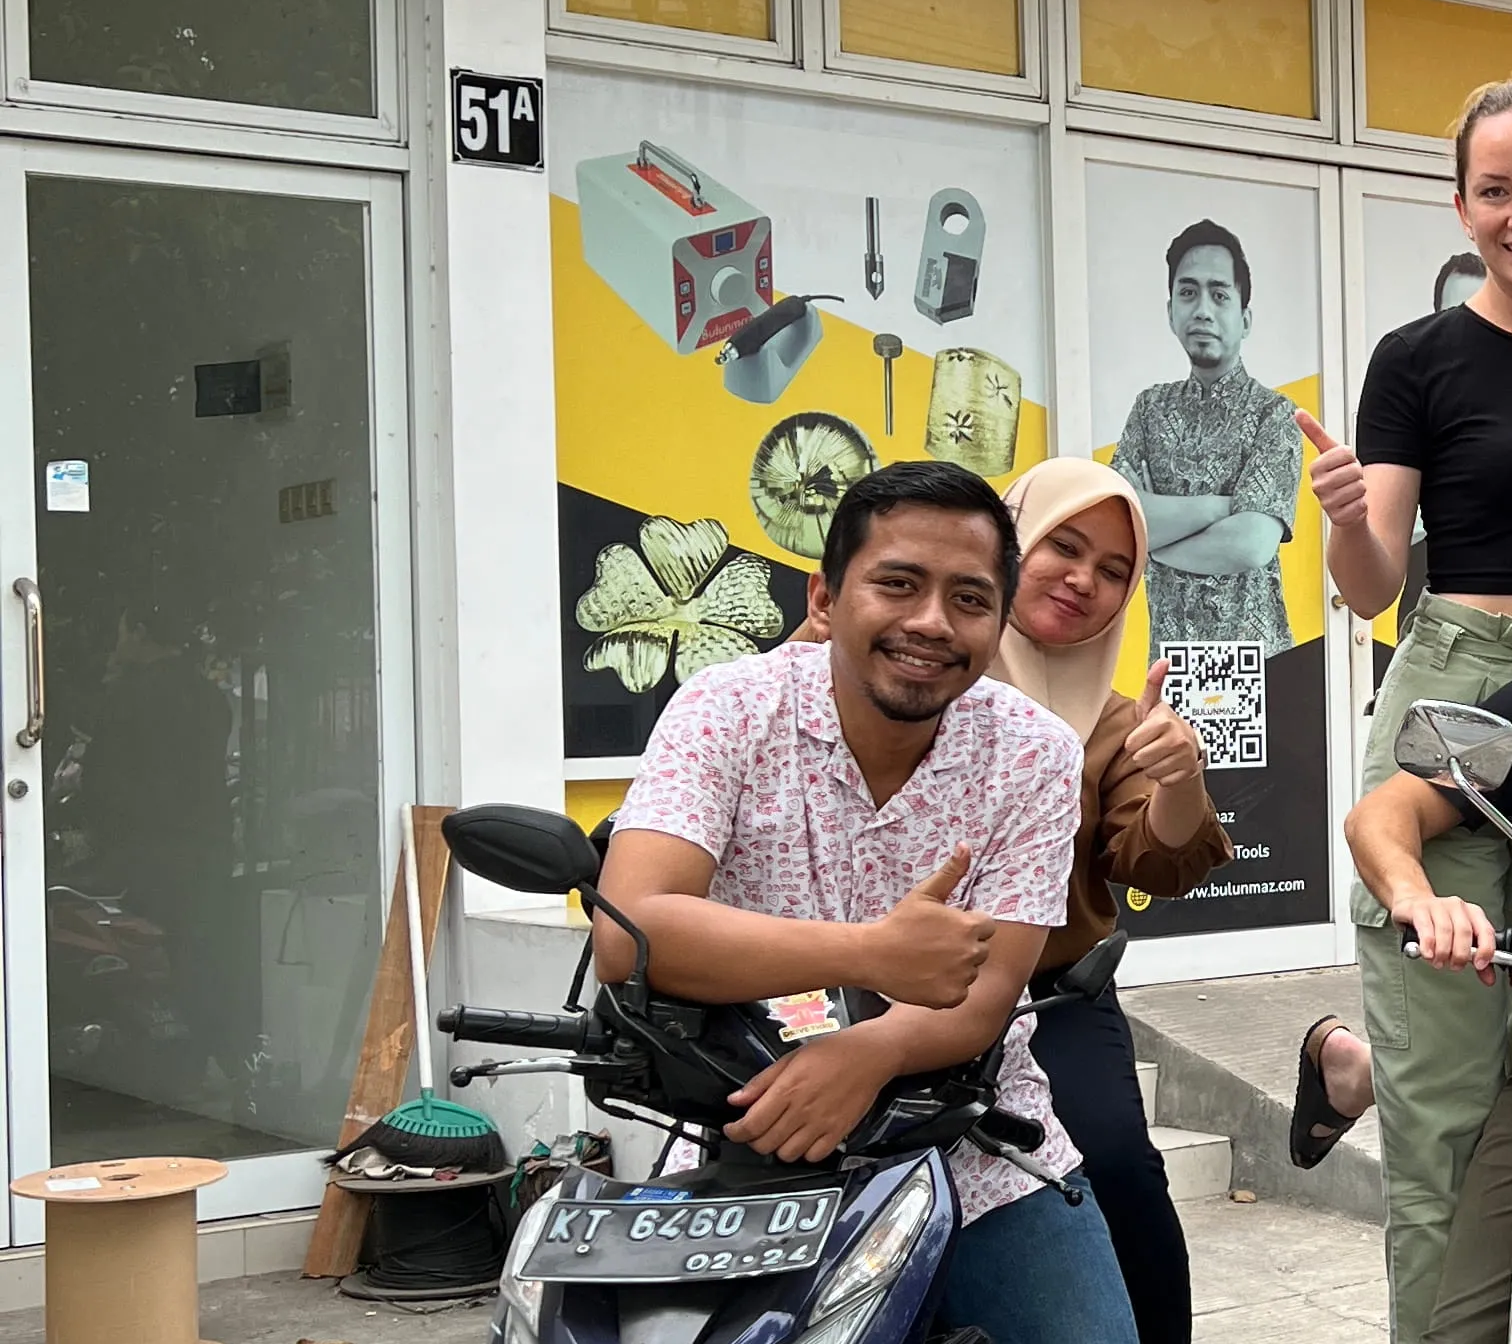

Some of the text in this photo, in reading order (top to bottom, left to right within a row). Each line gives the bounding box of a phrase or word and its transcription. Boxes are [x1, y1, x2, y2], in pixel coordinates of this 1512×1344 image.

[1191, 707, 1237, 717] BULUNMAZ
[548, 1198, 831, 1242] KT 6460 DJ
